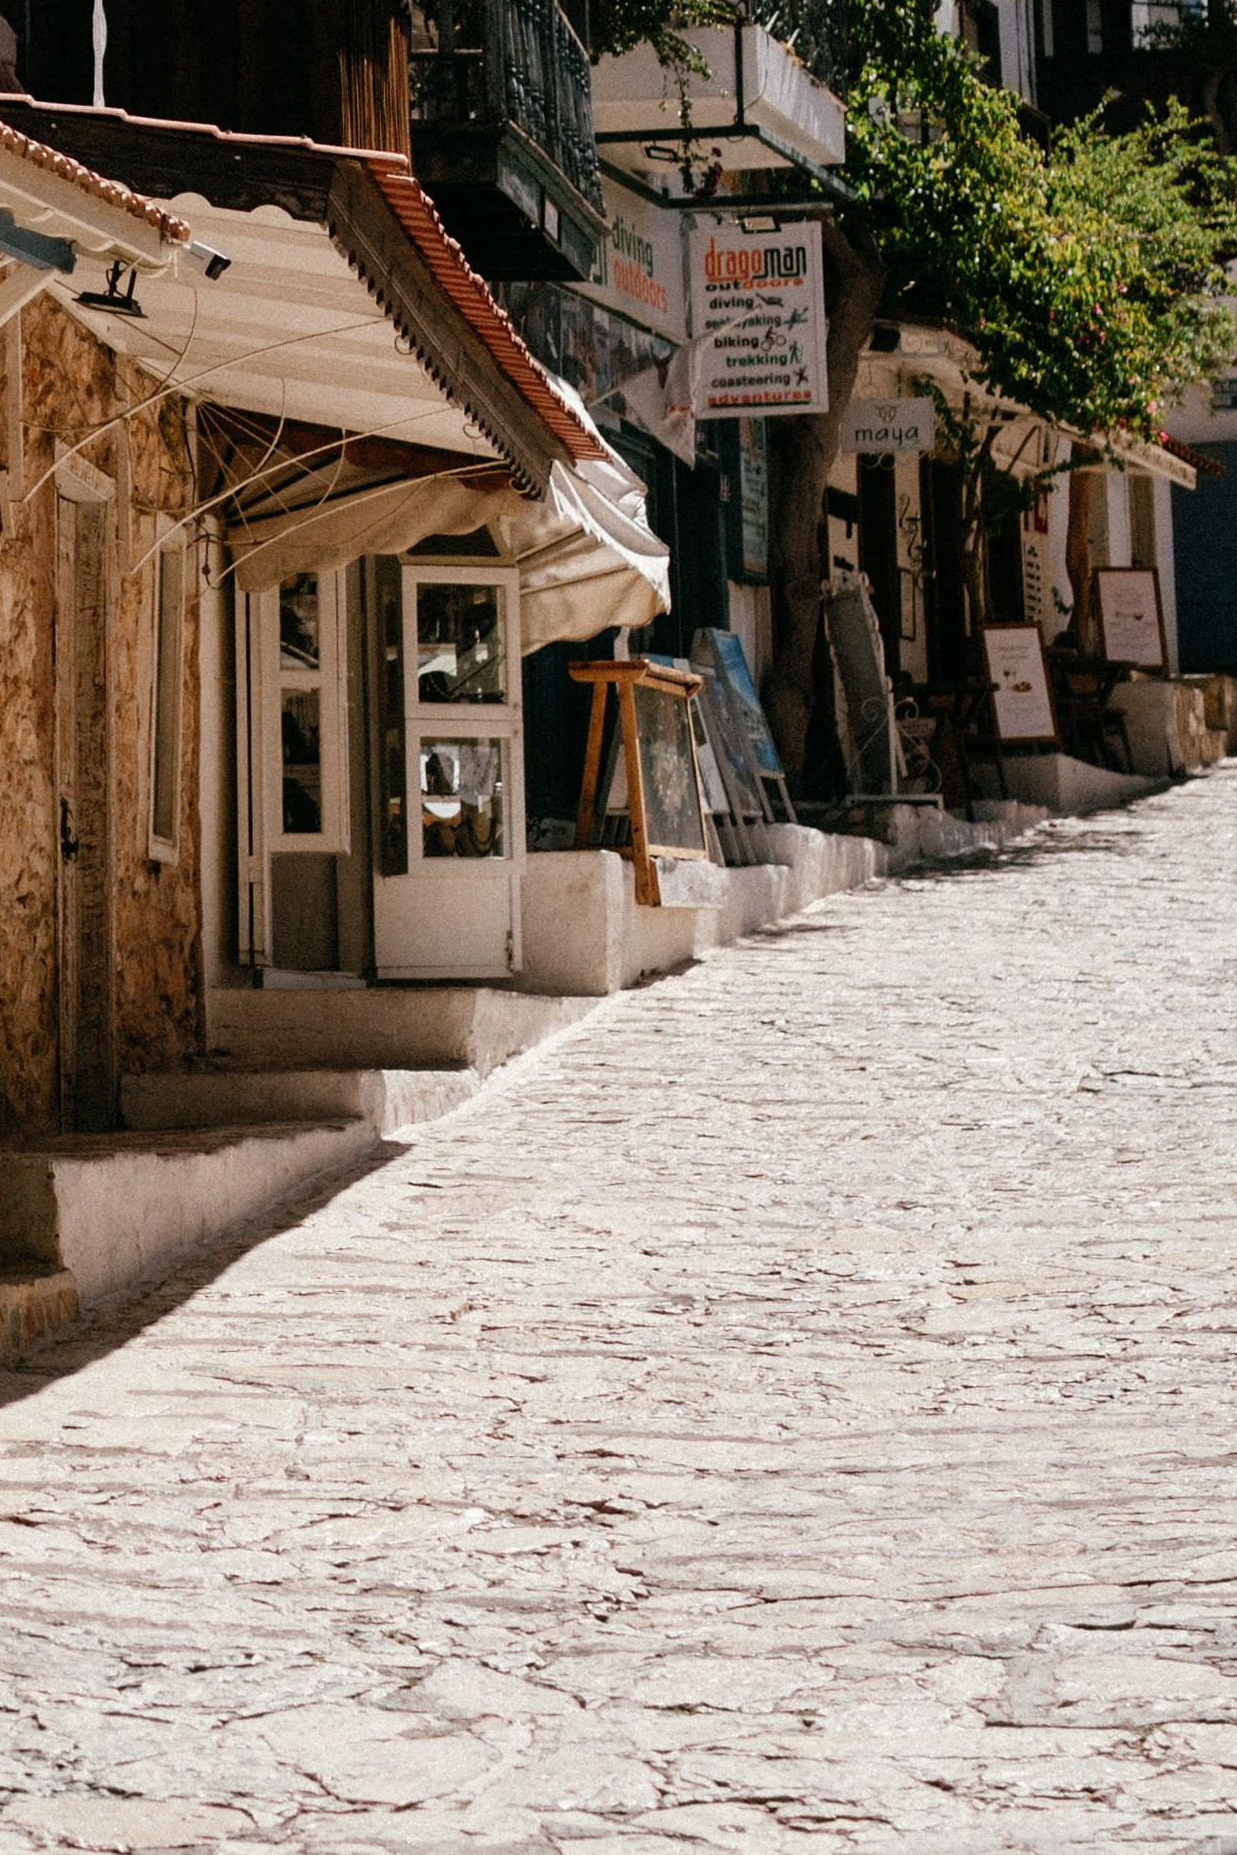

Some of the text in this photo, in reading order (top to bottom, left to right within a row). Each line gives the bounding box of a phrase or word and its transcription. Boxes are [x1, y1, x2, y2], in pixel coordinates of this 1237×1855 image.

[612, 215, 653, 277] diving
[704, 237, 807, 282] dragoman
[613, 258, 668, 314] outdoors
[705, 277, 804, 292] outdoors
[709, 296, 754, 310] diving
[714, 334, 759, 349] biking
[726, 352, 788, 367] trekking
[712, 372, 791, 388] coasteering
[707, 390, 812, 406] adventures
[854, 426, 919, 446] maya
